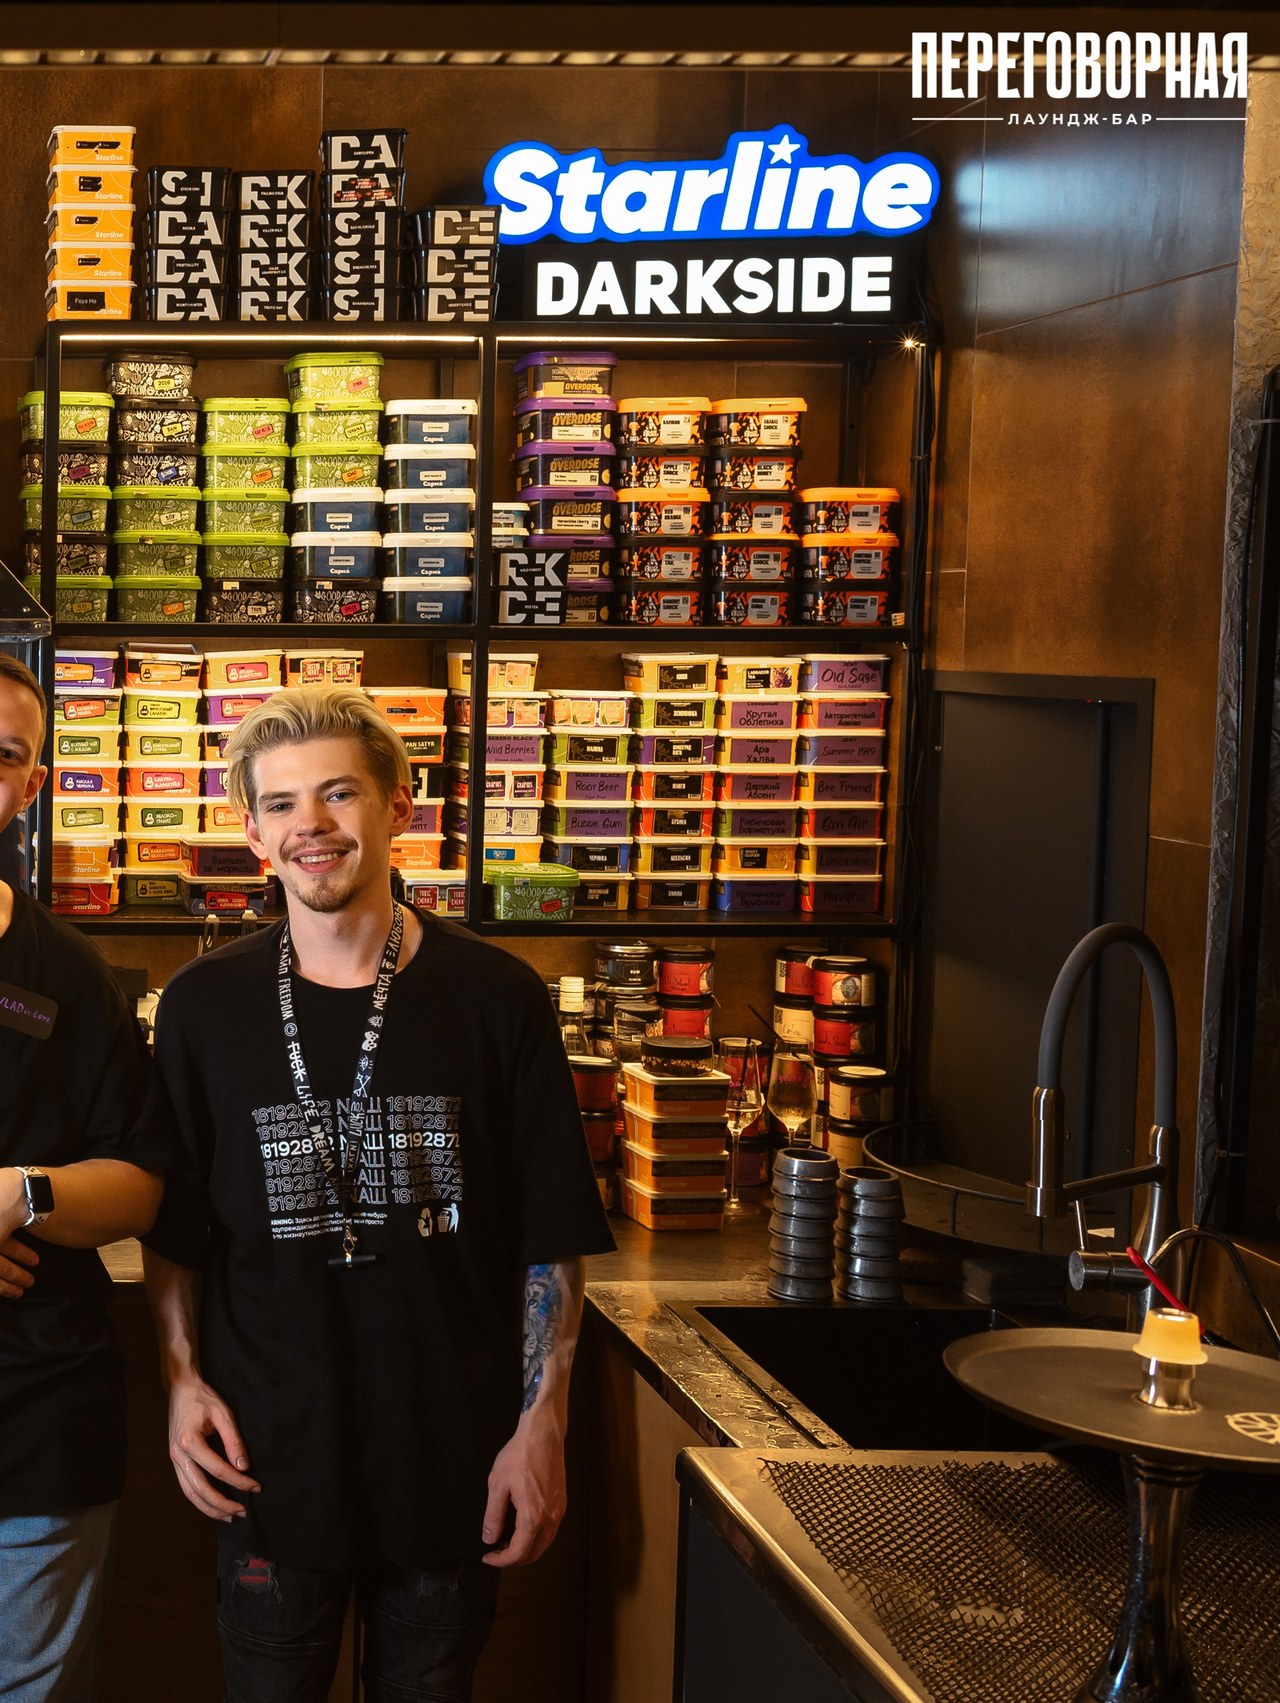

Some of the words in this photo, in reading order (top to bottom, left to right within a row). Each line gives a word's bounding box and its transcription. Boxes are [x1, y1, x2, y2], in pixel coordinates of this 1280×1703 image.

[492, 136, 923, 237] Starline
[94, 192, 123, 200] Starline
[94, 269, 122, 277] Starline
[537, 257, 891, 315] DARKSIDE
[553, 412, 602, 425] OVERDOSE
[550, 458, 599, 471] OVERDOSE
[553, 502, 602, 515] OVERDOSE
[822, 669, 846, 683] Old
[849, 669, 877, 684] Sage
[746, 710, 777, 719] Крутая
[739, 717, 784, 726] Облепиха
[505, 744, 535, 755] Berries
[753, 745, 770, 755] Ара
[822, 747, 854, 756] Summer
[858, 746, 876, 756] 1919
[746, 754, 775, 763] Халва
[575, 780, 597, 791] Root
[598, 780, 619, 791] Beer
[745, 782, 780, 791] Дерзкий
[817, 781, 835, 793] Bee
[839, 780, 871, 793] Friend
[602, 817, 623, 828] Gum
[739, 818, 786, 827] Рябиновая
[848, 816, 869, 830] Air
[739, 827, 786, 835] Бормотуха
[212, 855, 247, 865] Выпьем
[405, 859, 433, 867] Starline
[216, 865, 255, 875] морковь
[373, 973, 392, 1012] МЕЧТА
[277, 977, 294, 1021] FREEDOM
[308, 1125, 334, 1174] DREAM
